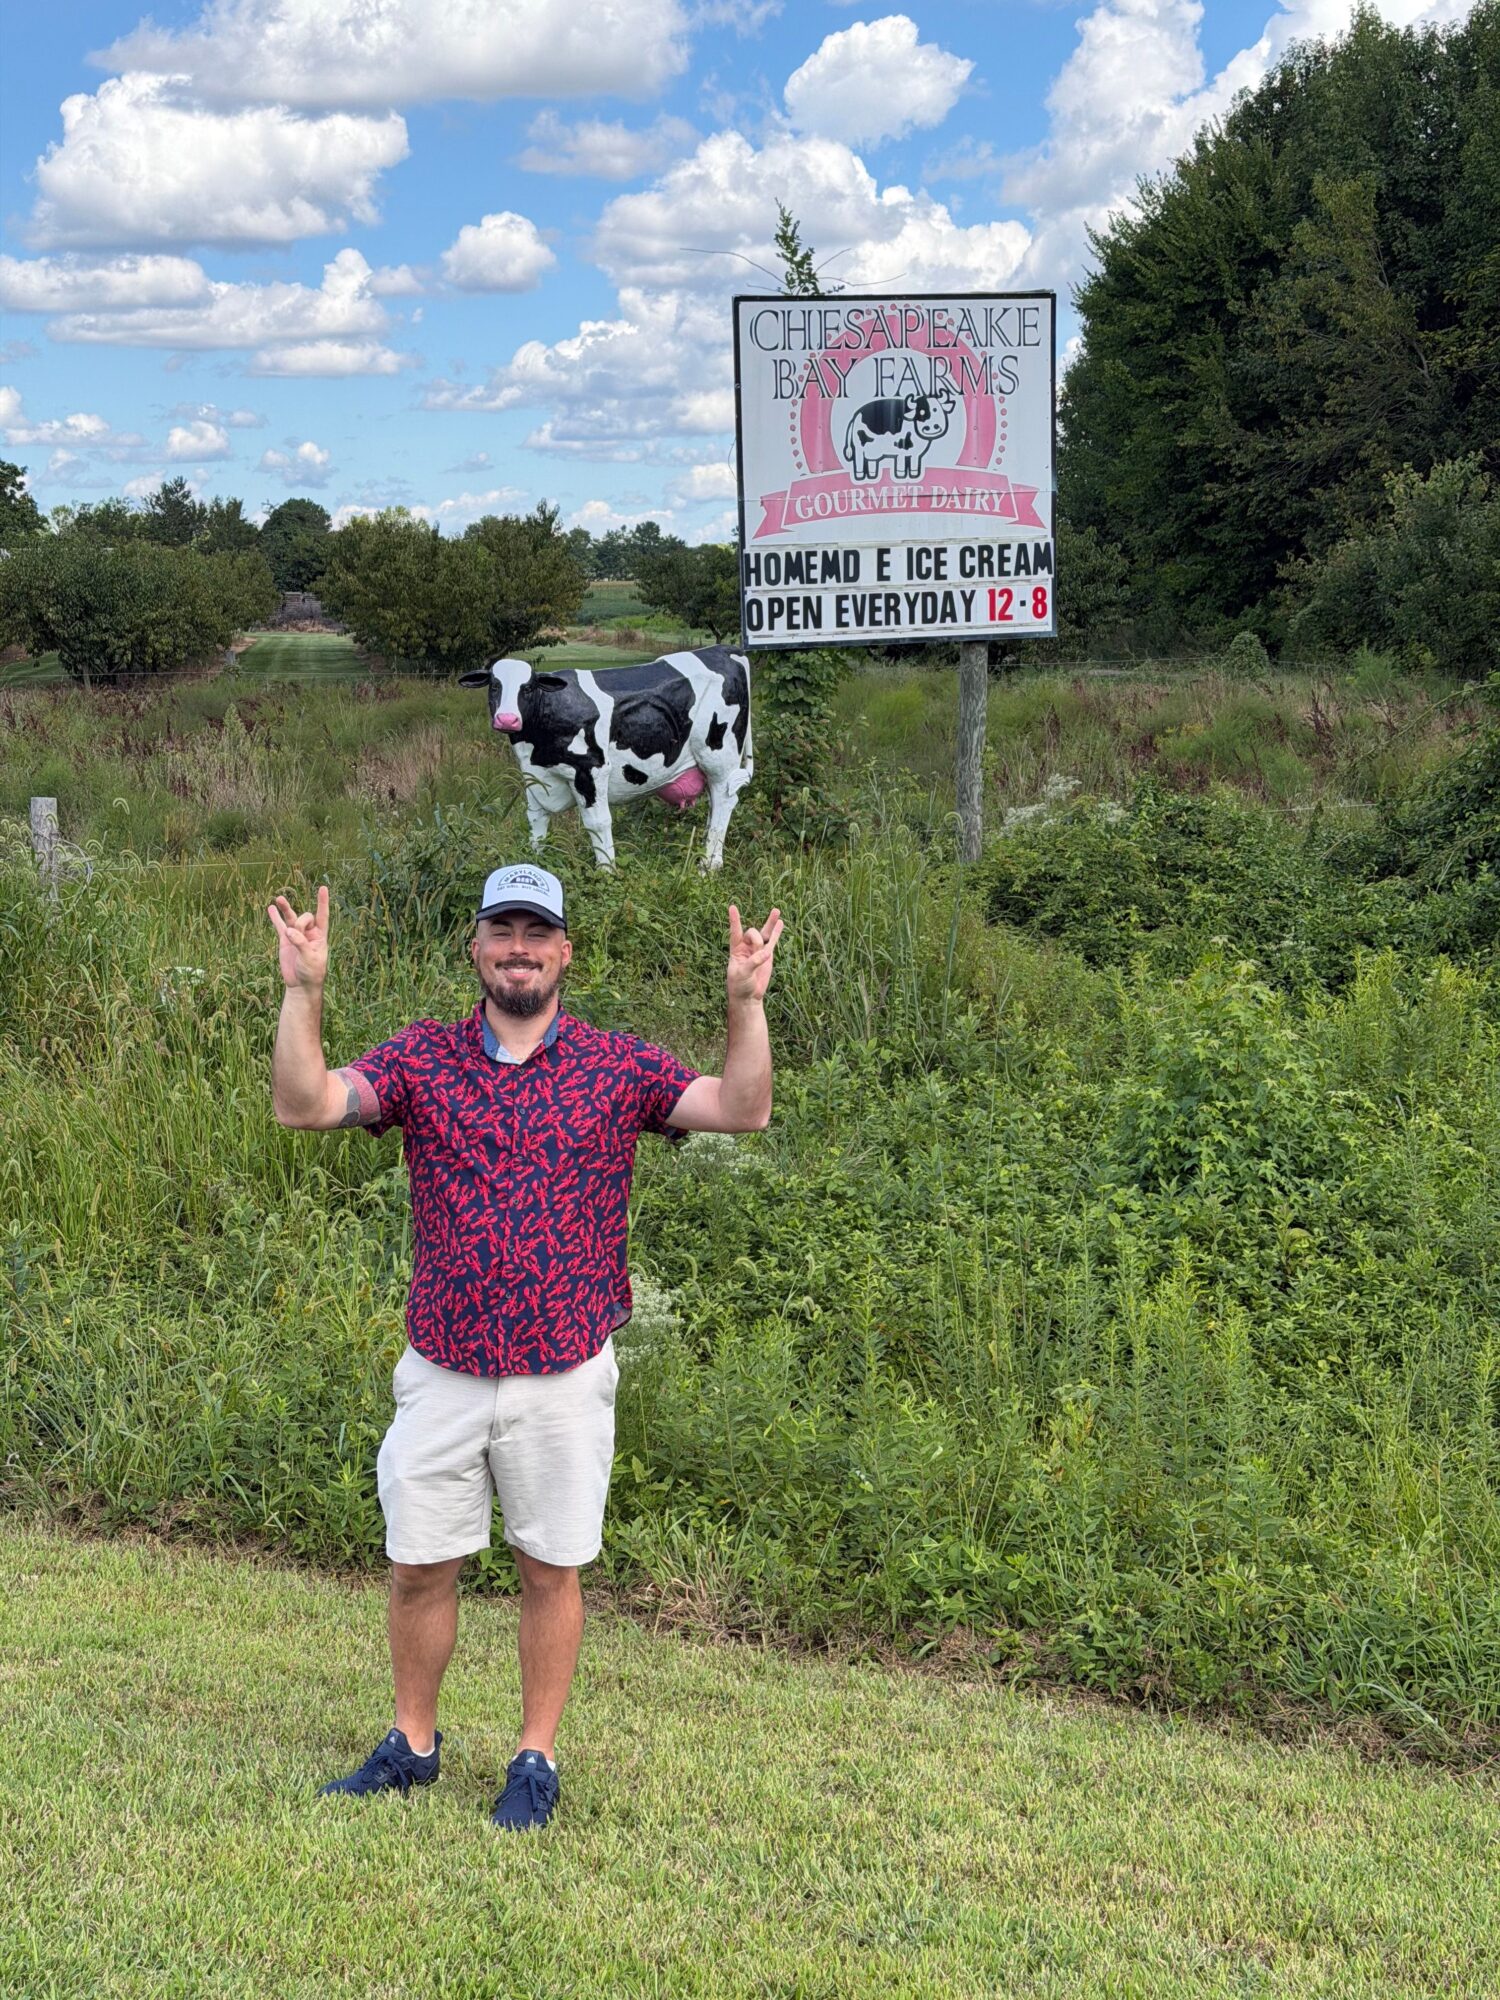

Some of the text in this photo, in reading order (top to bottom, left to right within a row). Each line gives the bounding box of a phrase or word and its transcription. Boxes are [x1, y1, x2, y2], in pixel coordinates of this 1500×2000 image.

[750, 307, 1042, 350] CHESAPEAKE
[773, 355, 1020, 400] BAY FARMS
[795, 485, 1006, 519] GOURMET DAIRY
[907, 547, 948, 581] ICE
[959, 541, 1052, 578] CREAM
[746, 595, 822, 632] OPEN
[835, 589, 976, 628] EVERYDAY
